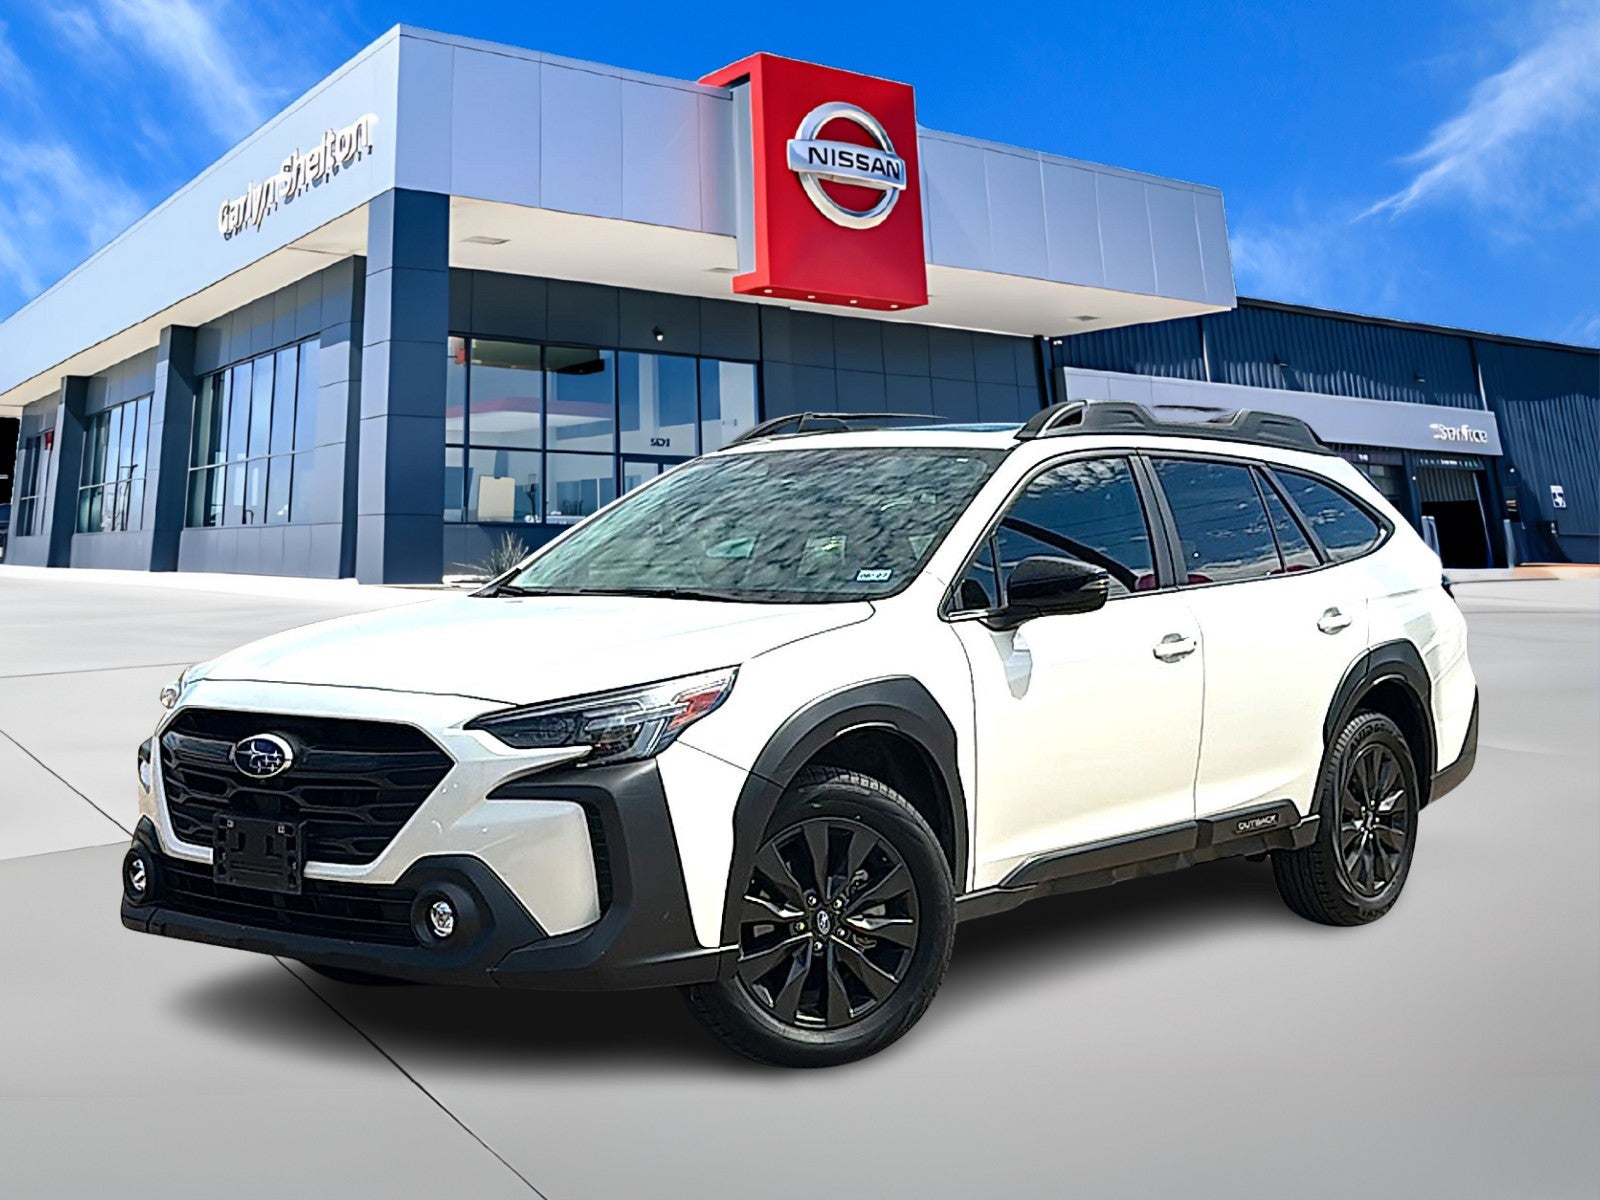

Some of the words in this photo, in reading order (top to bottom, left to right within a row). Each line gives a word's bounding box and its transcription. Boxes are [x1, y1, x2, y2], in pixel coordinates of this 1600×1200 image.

[278, 114, 376, 200] Shelton
[808, 146, 900, 180] NISSAN
[1238, 814, 1278, 830] OUTBACK
